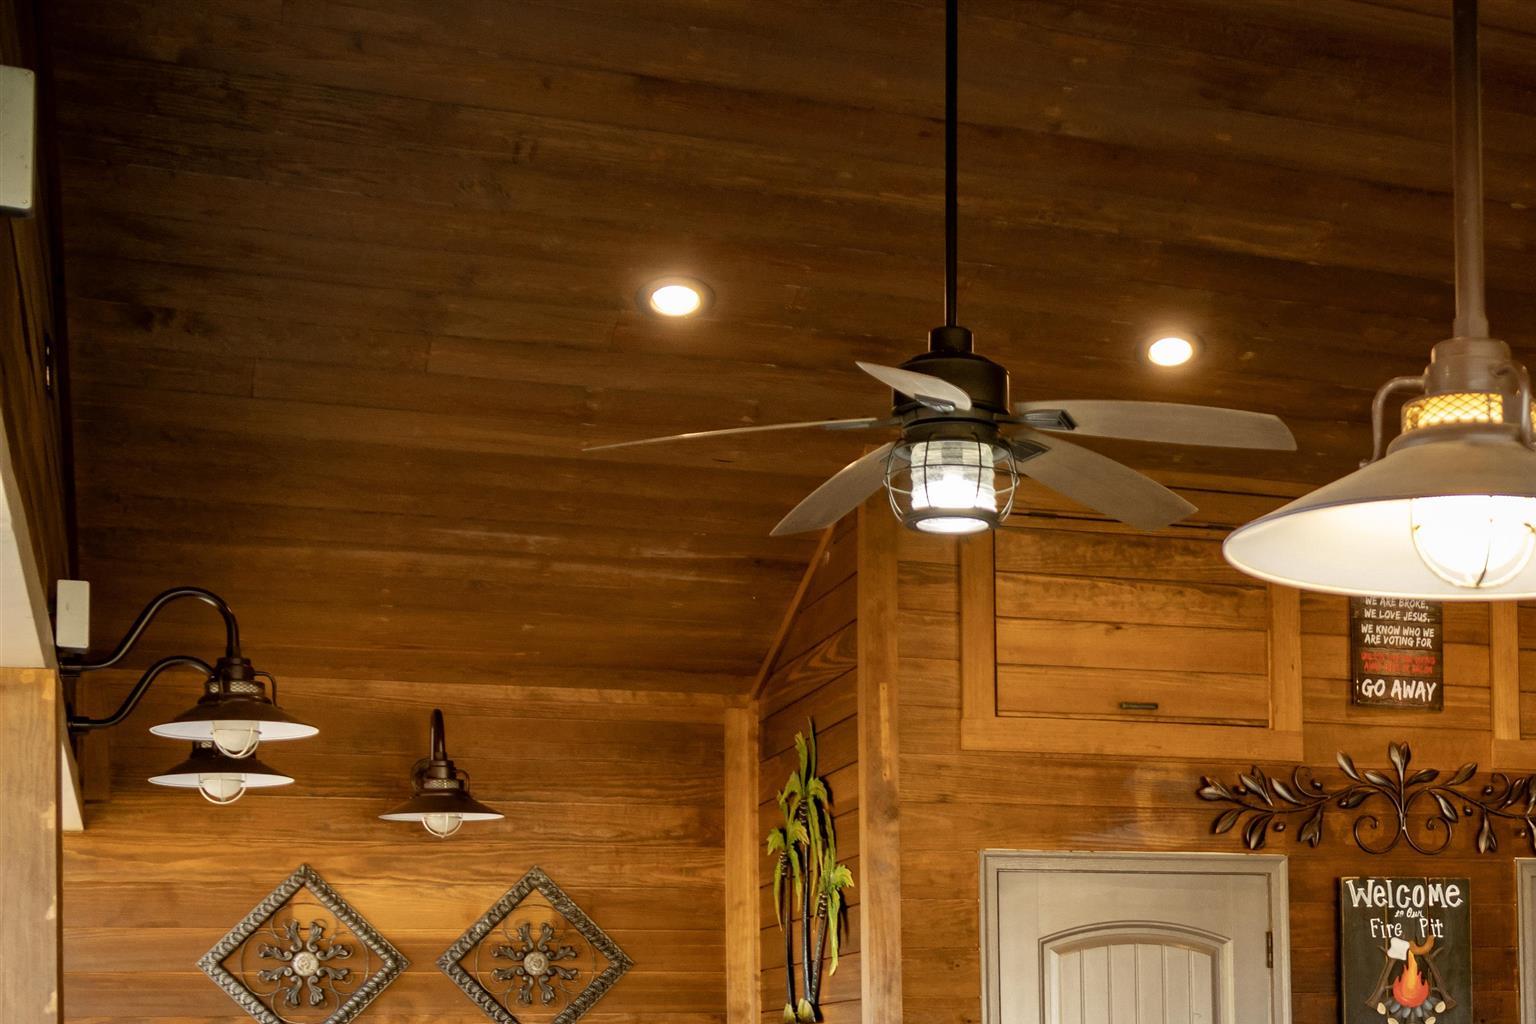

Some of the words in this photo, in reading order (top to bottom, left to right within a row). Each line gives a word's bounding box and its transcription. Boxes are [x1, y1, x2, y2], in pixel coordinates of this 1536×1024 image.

[1365, 596, 1377, 606] WE
[1380, 597, 1396, 607] ARE
[1364, 608, 1377, 618] WE
[1379, 609, 1401, 620] LOVE
[1361, 624, 1374, 634] WE
[1376, 625, 1401, 635] KNOW
[1402, 626, 1421, 637] WHO
[1422, 628, 1435, 638] WE
[1364, 633, 1381, 645] ARE
[1383, 635, 1415, 648] VOTING
[1416, 637, 1433, 649] FOR
[1361, 678, 1386, 698] GO
[1390, 679, 1437, 703] AWAY
[1369, 917, 1403, 938] Fire
[1419, 917, 1444, 938] Pit
